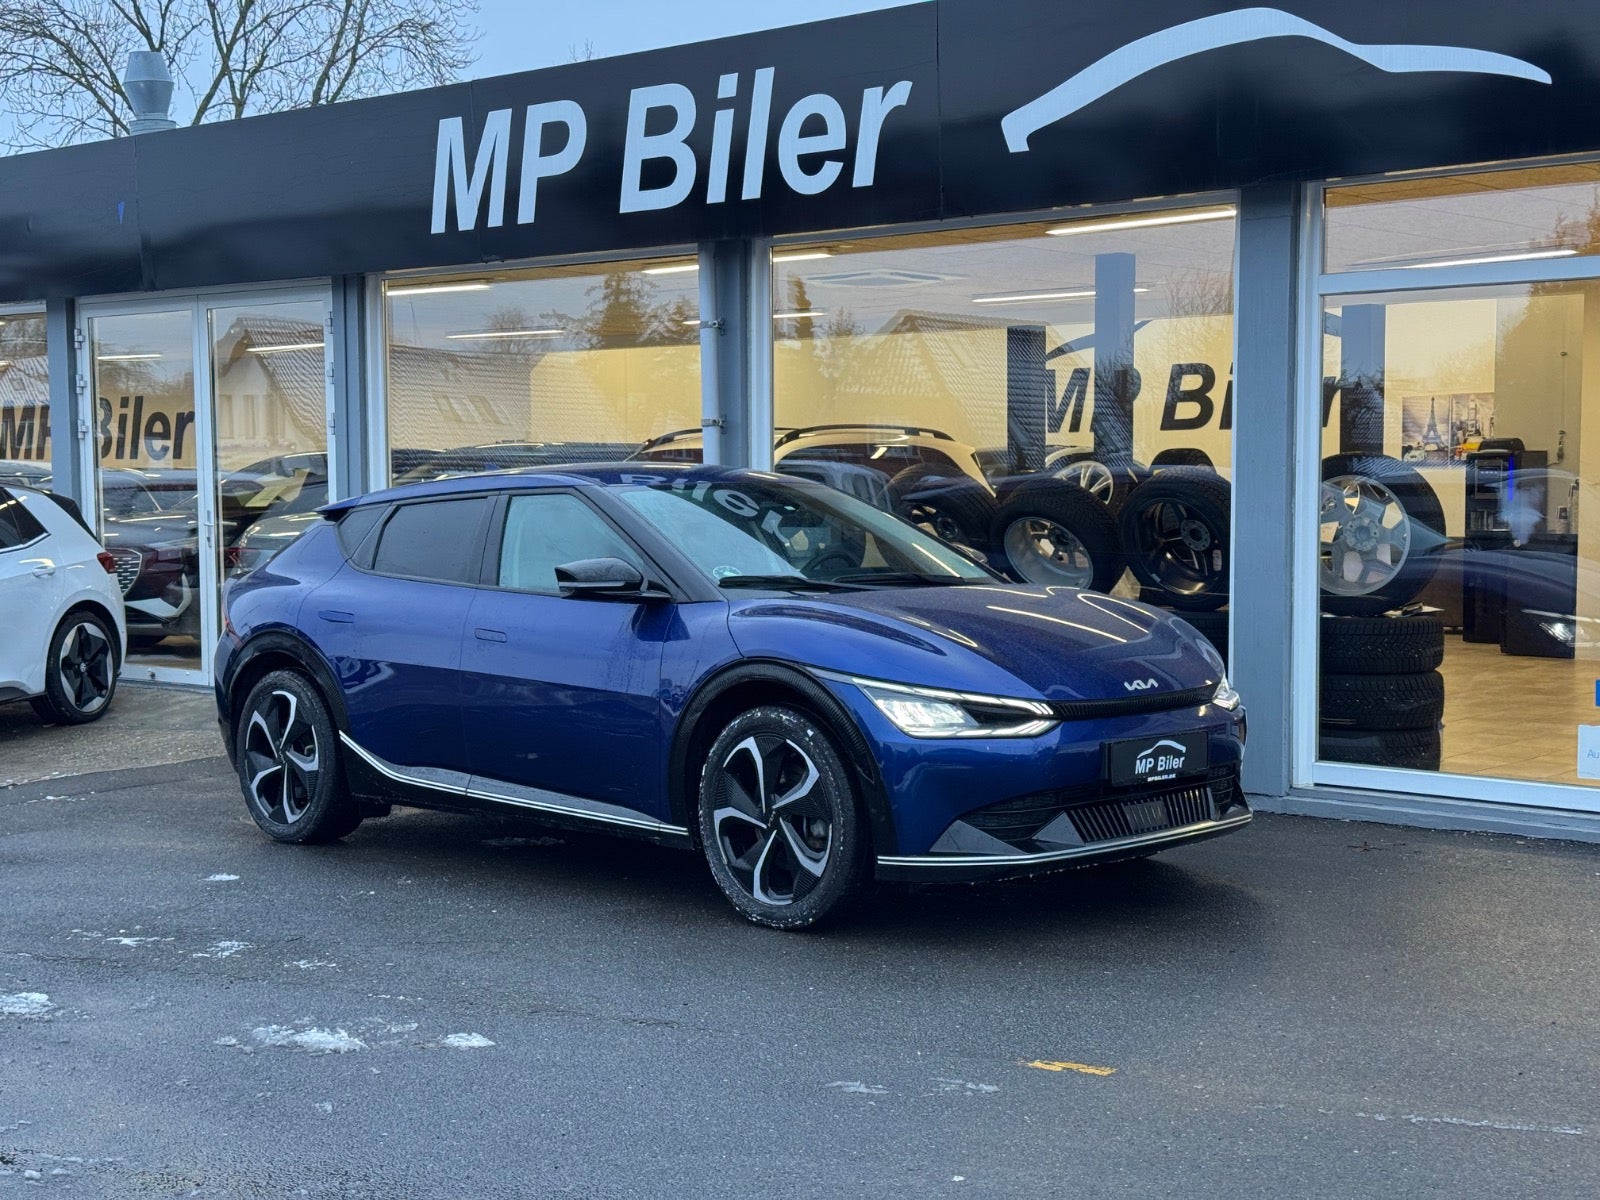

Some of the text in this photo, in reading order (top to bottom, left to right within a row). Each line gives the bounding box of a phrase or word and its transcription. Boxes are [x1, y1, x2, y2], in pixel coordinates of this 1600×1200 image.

[430, 66, 913, 235] MP Biler
[1134, 754, 1186, 775] MP Biler
